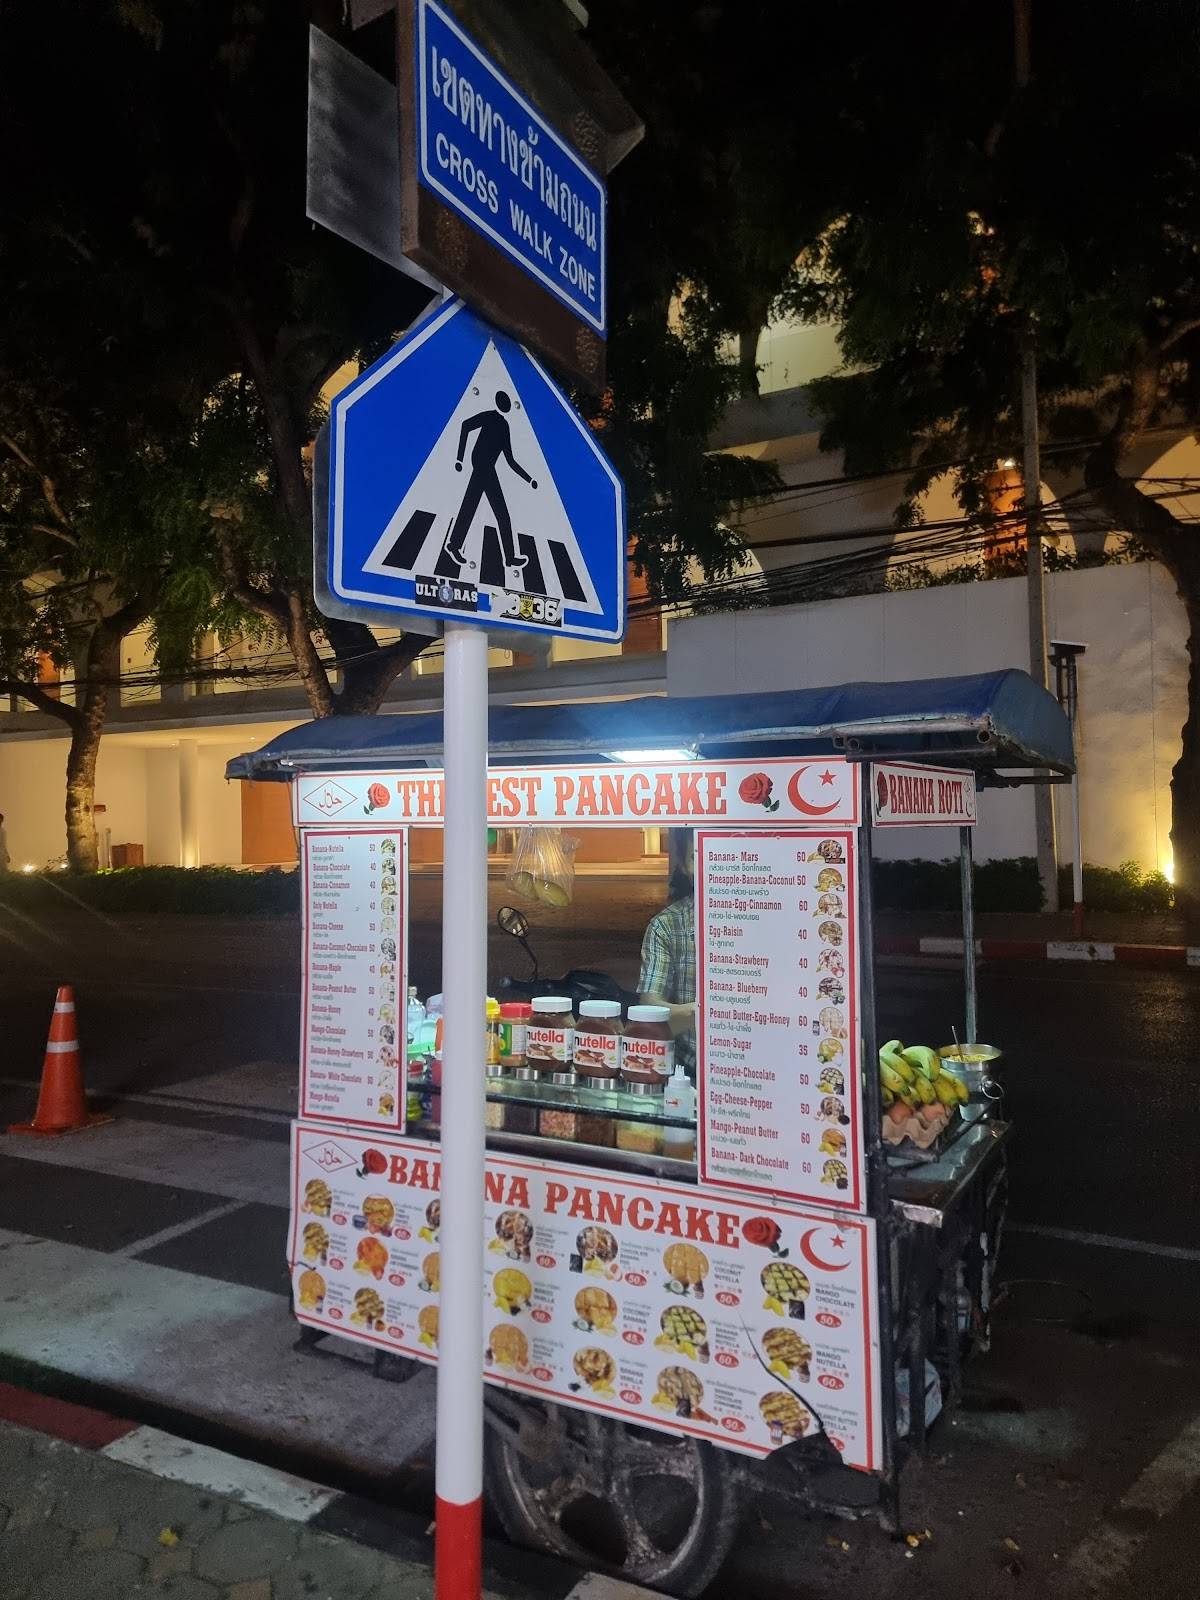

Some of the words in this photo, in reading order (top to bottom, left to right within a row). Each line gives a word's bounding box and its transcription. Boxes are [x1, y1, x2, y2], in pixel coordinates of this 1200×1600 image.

[432, 46, 597, 252] เขตทางข้ามถนน
[436, 133, 499, 214] CROSS
[510, 199, 553, 264] WALK
[559, 246, 596, 302] ZONE
[487, 777, 542, 816] EST
[553, 771, 727, 816] PANCAKE
[889, 774, 935, 814] BANANA
[938, 780, 963, 814] ROTI
[709, 851, 738, 862] Banana-
[741, 852, 758, 862] Mars
[796, 851, 806, 862] 60
[709, 875, 795, 886] Pineapple-Banana-Coconut
[796, 875, 806, 886] 50
[709, 898, 782, 912] Banana-Egg-Cinnamon
[799, 900, 808, 911] 60
[709, 925, 743, 937] Egg-Raisin
[798, 929, 807, 939] 40
[709, 952, 769, 968] Banana-Strawberry
[798, 958, 808, 969] 40
[709, 981, 735, 992] Banana-
[737, 982, 768, 996] Blueberry
[798, 987, 807, 998] 40
[710, 1008, 731, 1021] Peanut
[733, 1012, 790, 1028] Butter-Egg-Honey
[798, 1016, 807, 1026] 60
[527, 1029, 564, 1044] nutella
[575, 1034, 615, 1050] nutella
[623, 1041, 665, 1056] nutella
[710, 1036, 751, 1052] Lemon-Sugar
[799, 1045, 808, 1055] 35
[710, 1063, 775, 1081] Pineapple-Chocolate
[800, 1074, 809, 1085] 50
[710, 1091, 772, 1110] Egg-Cheese-Pepper
[800, 1104, 810, 1114] 50
[711, 1120, 757, 1136] Mango-Peanut
[759, 1126, 778, 1139] Butter
[801, 1133, 810, 1144] 60
[711, 1148, 738, 1162] Banana-
[740, 1152, 755, 1164] Dark
[756, 1154, 789, 1170] Chocolate
[802, 1162, 811, 1173] 60
[388, 1155, 530, 1209] BANA
[544, 1181, 740, 1249] PANCAKE
[815, 1288, 840, 1299] MANGO
[815, 1296, 855, 1309] CHOCOLATE
[816, 1350, 842, 1362] MANGO
[816, 1357, 847, 1370] NUTELLA
